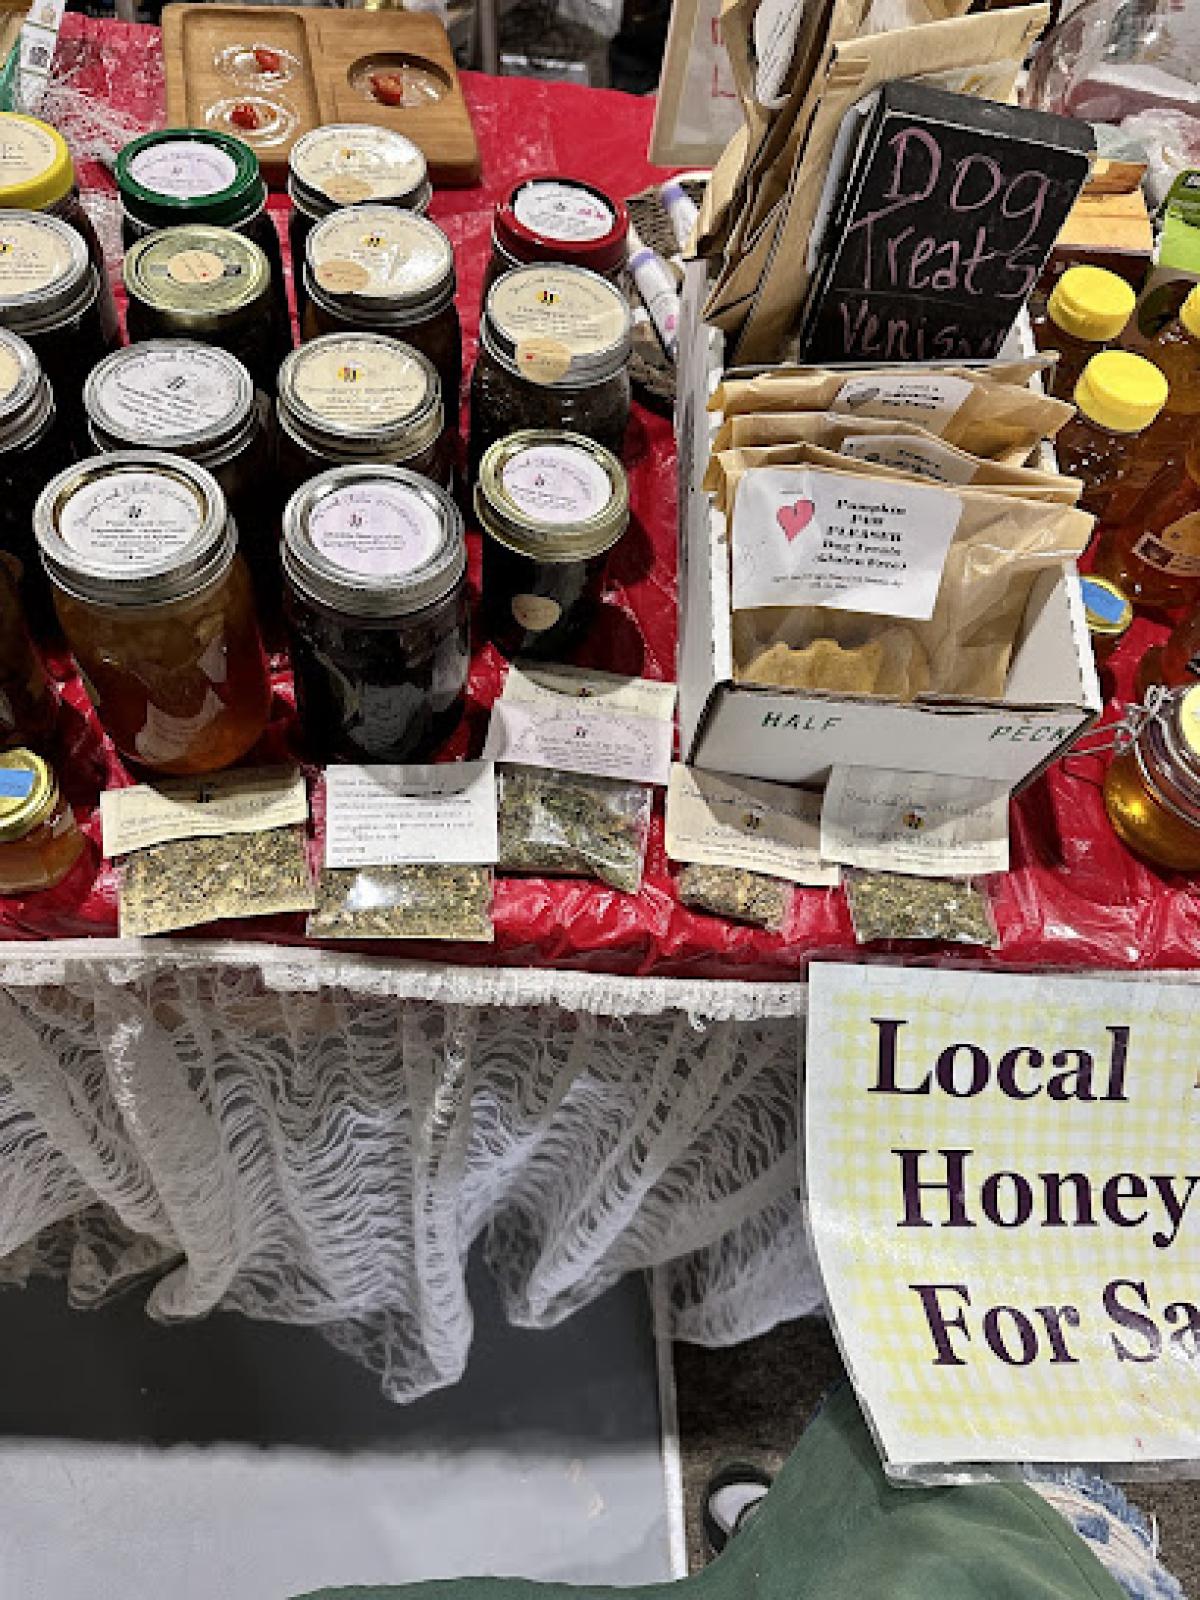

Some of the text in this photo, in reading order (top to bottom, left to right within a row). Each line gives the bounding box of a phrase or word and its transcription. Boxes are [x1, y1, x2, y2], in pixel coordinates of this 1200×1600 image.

[883, 128, 1050, 257] Dog
[847, 198, 1036, 298] Treats
[761, 711, 842, 730] HALF
[867, 1018, 1131, 1102] Local
[891, 1149, 1200, 1248] Honey
[908, 1284, 1081, 1366] For
